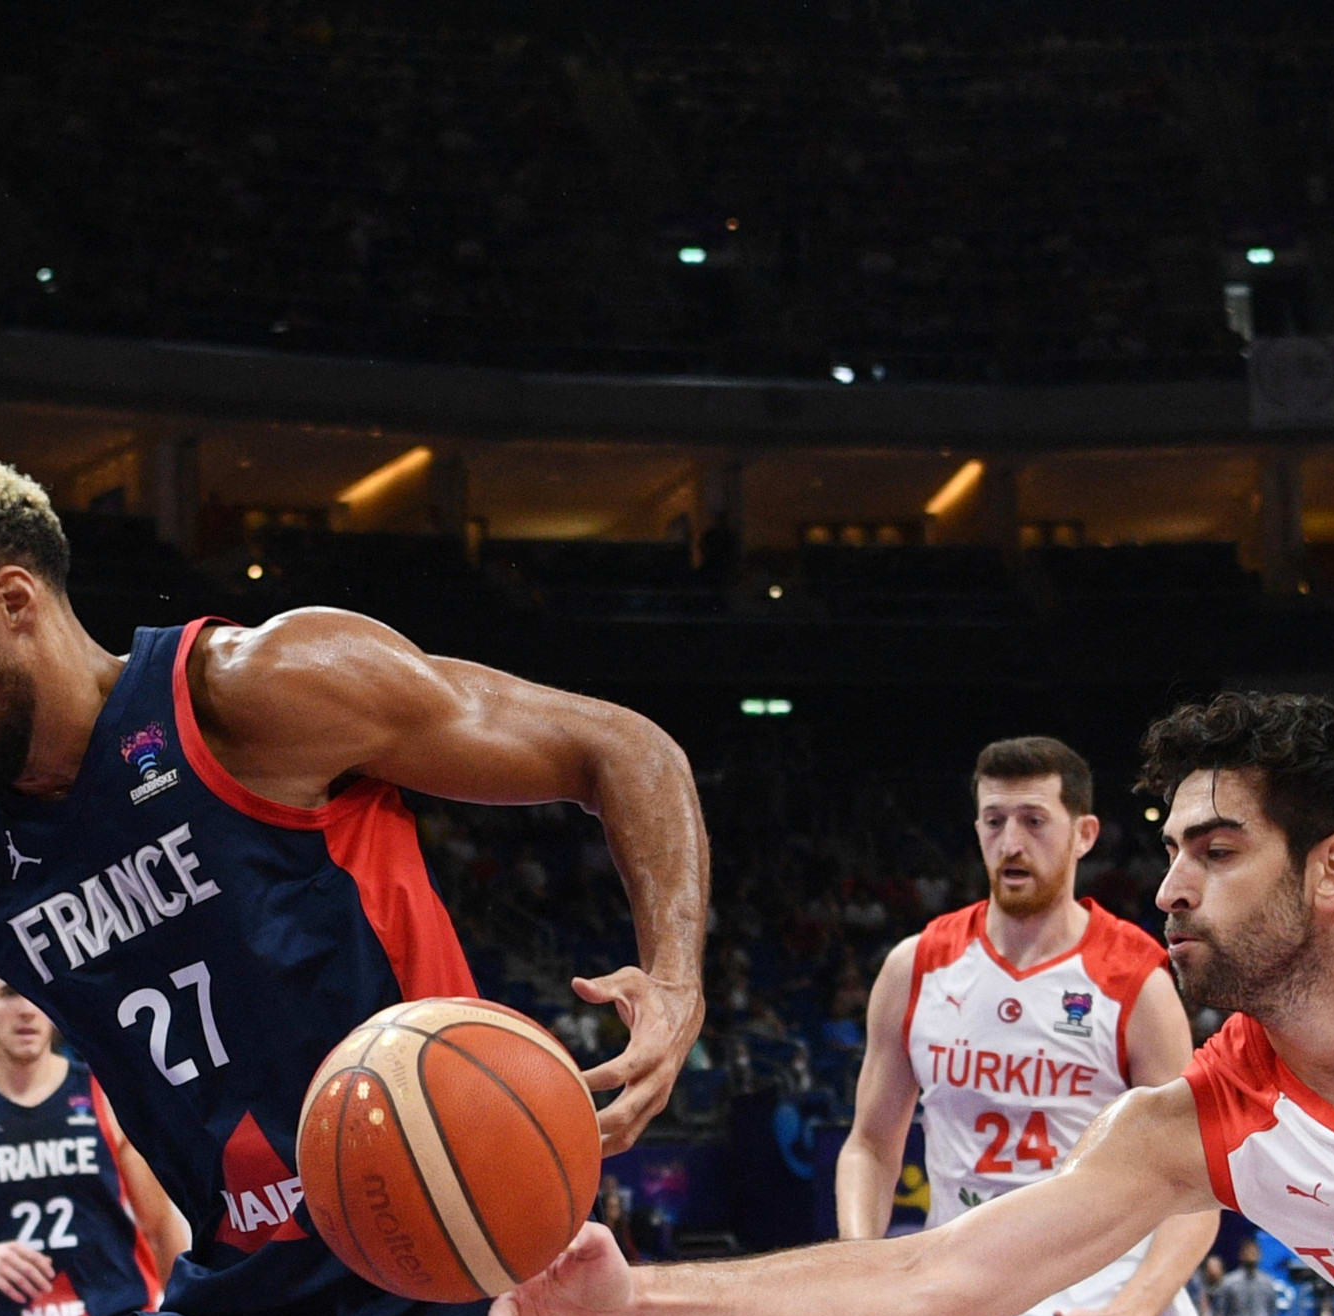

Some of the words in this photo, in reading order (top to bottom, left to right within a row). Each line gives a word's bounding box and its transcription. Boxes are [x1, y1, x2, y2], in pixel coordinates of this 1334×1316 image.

[8, 822, 222, 984] FRANCE
[117, 961, 230, 1086] 27
[928, 1038, 1098, 1097] TÜRKİYE
[974, 1111, 1058, 1173] 24
[11, 1197, 78, 1251] 22
